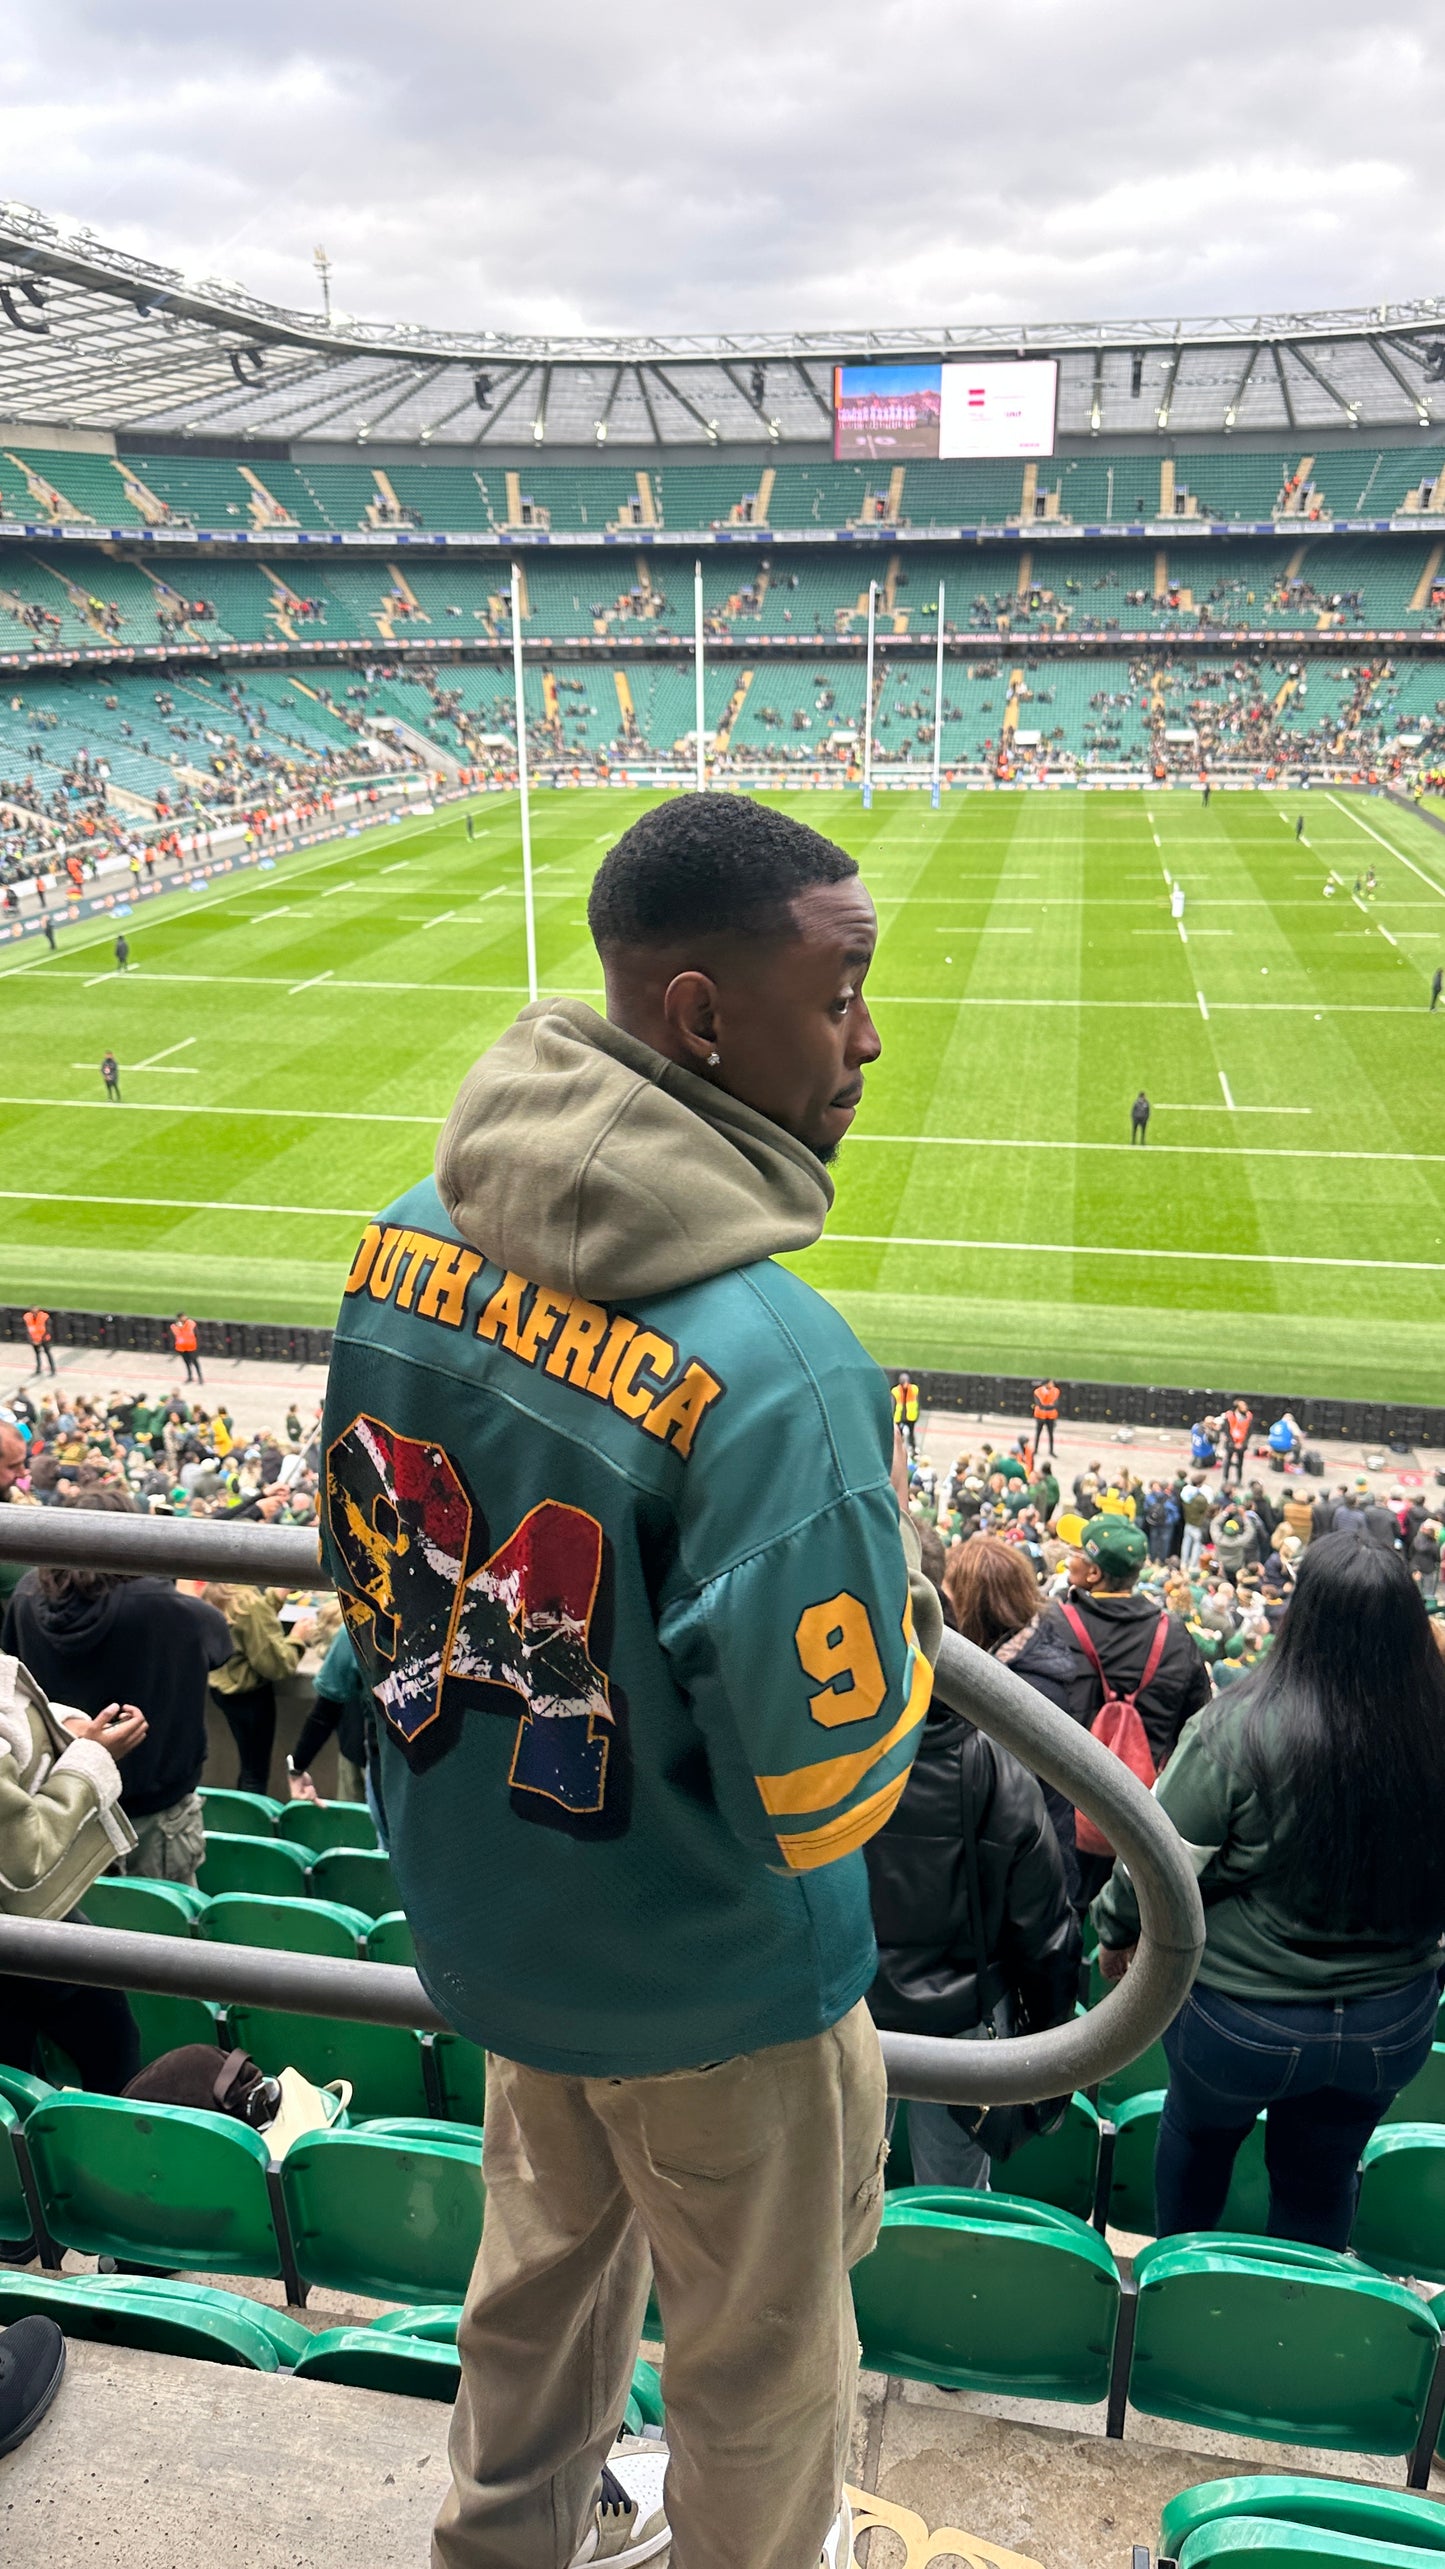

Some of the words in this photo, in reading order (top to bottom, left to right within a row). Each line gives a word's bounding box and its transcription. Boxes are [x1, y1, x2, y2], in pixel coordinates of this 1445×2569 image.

[344, 1223, 486, 1328] OUTH
[477, 1270, 724, 1461] AFRICA
[795, 1589, 892, 1729] 9
